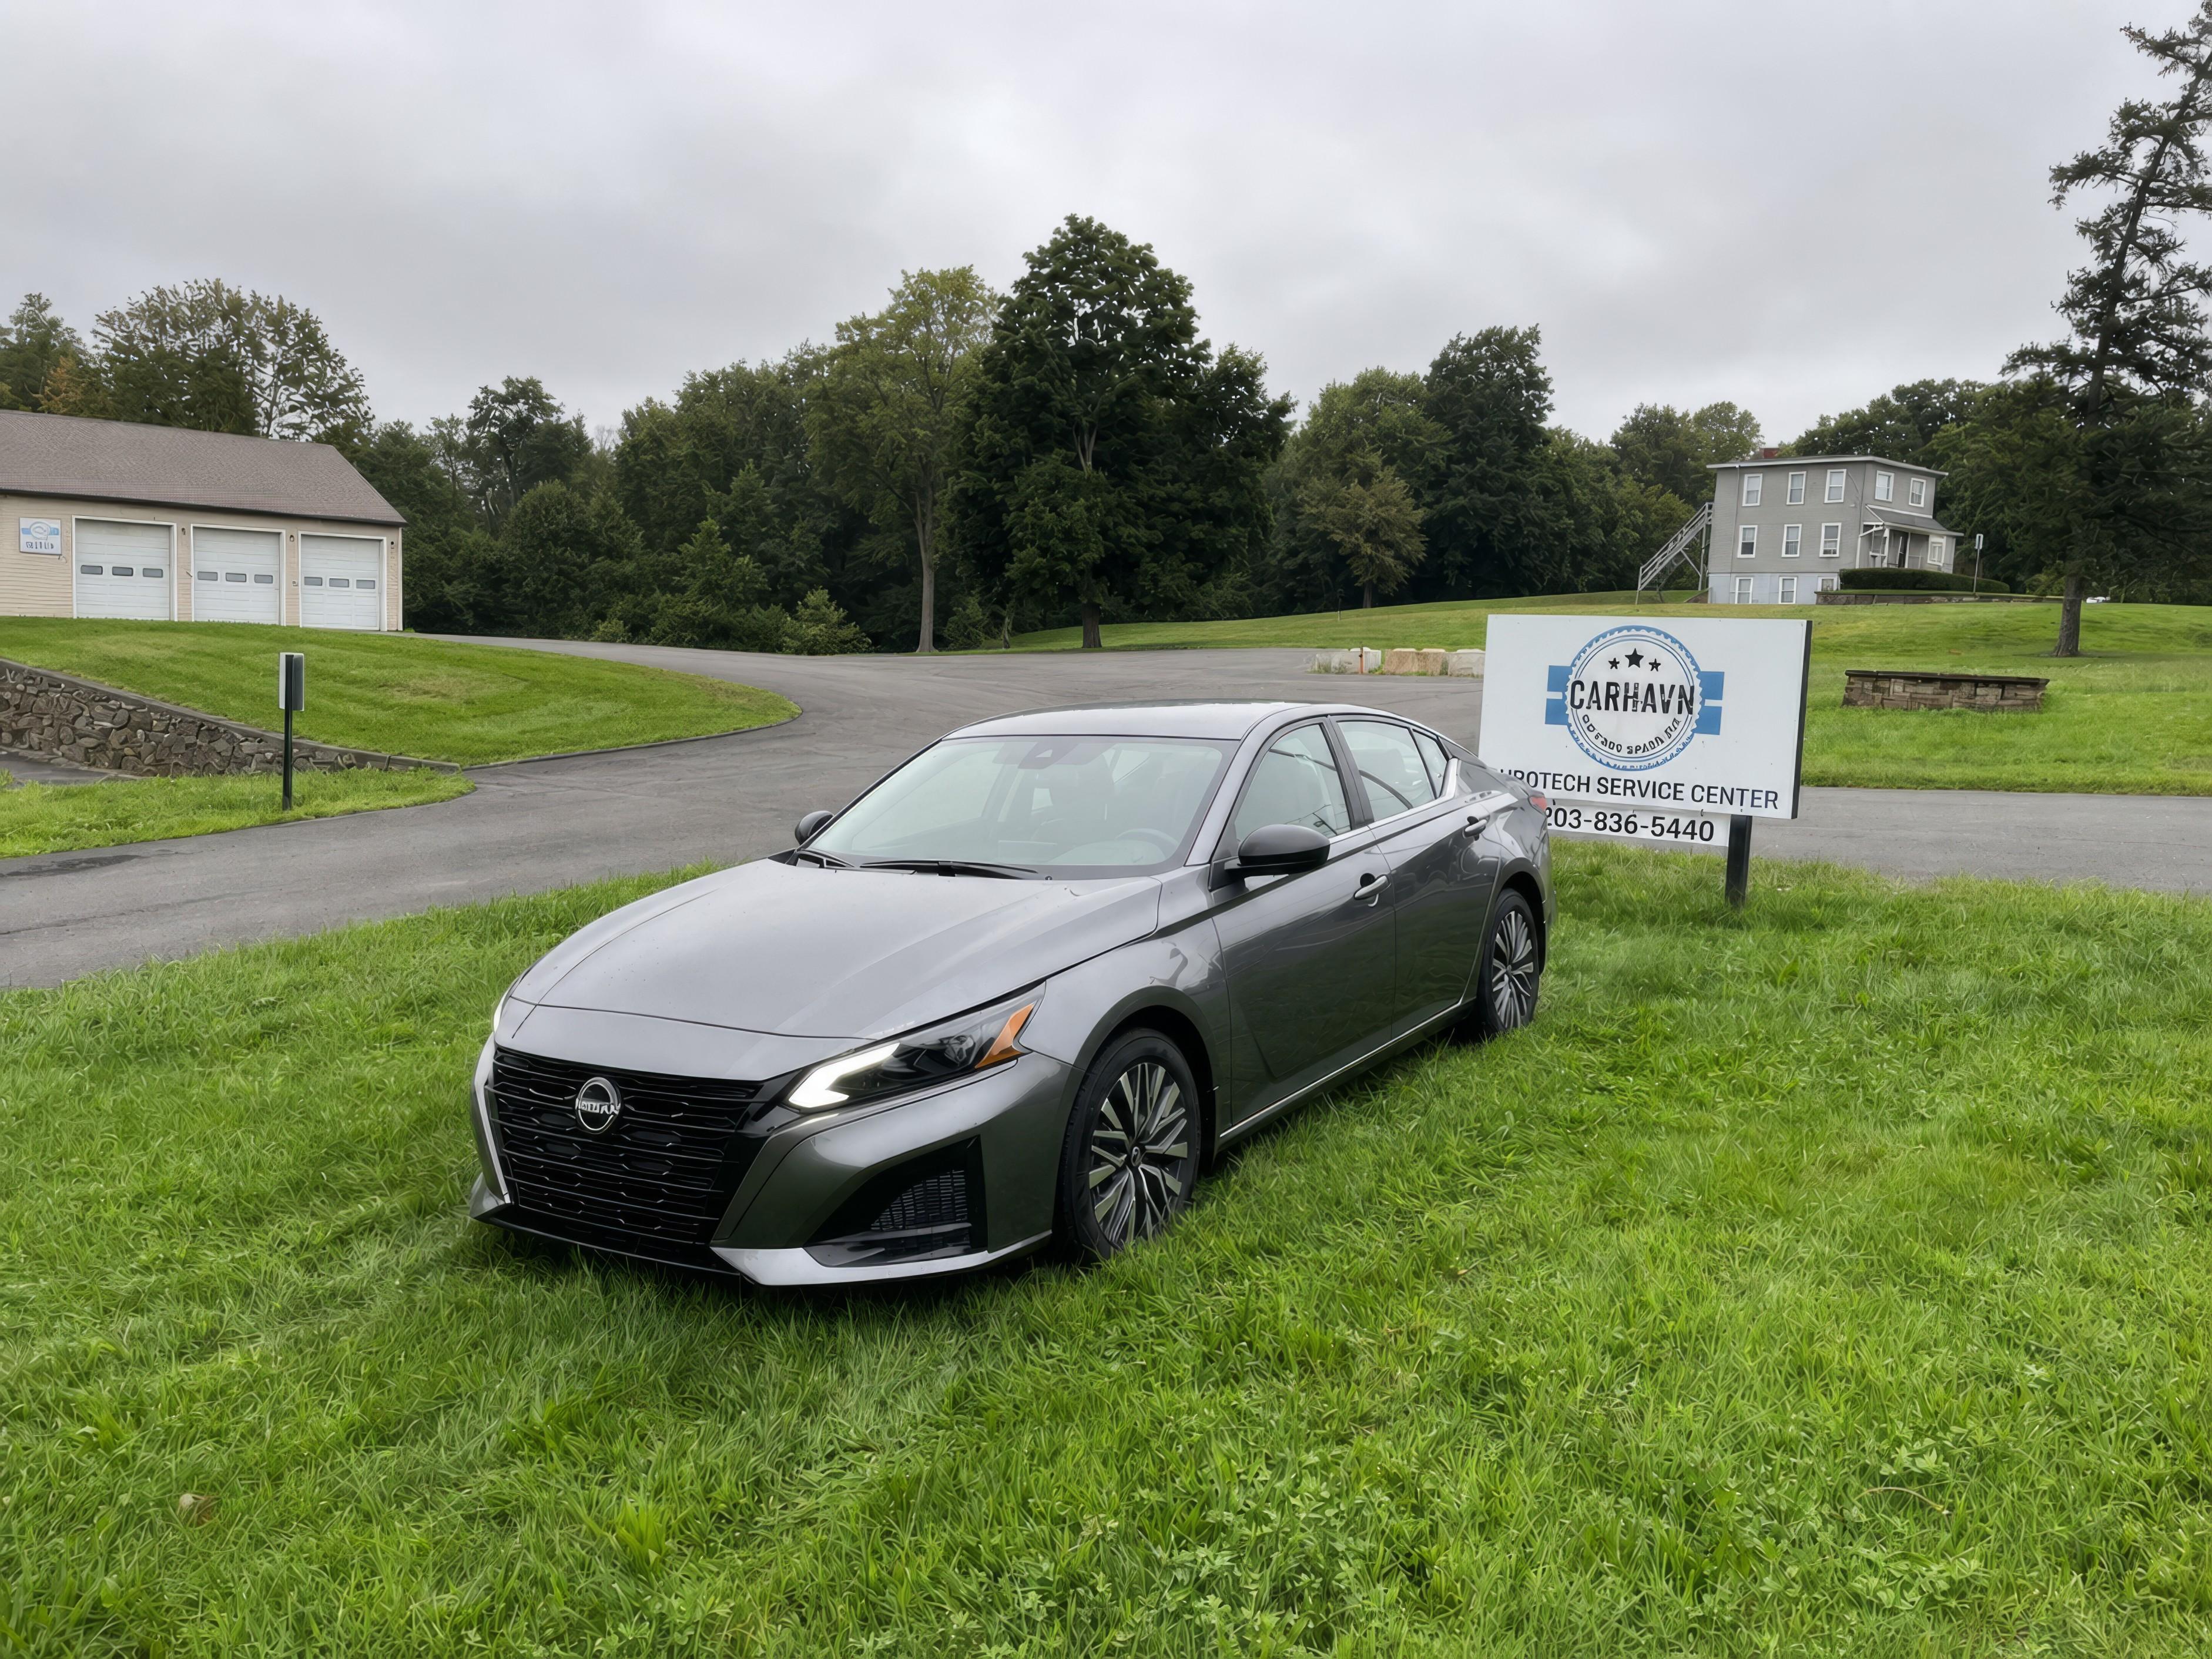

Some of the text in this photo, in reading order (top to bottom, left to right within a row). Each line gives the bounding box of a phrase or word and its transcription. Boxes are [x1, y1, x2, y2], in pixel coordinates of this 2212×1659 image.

[1570, 680, 1695, 715] CARHAVN
[1597, 776, 1685, 801] SERVICE
[1691, 785, 1778, 810] CENTER
